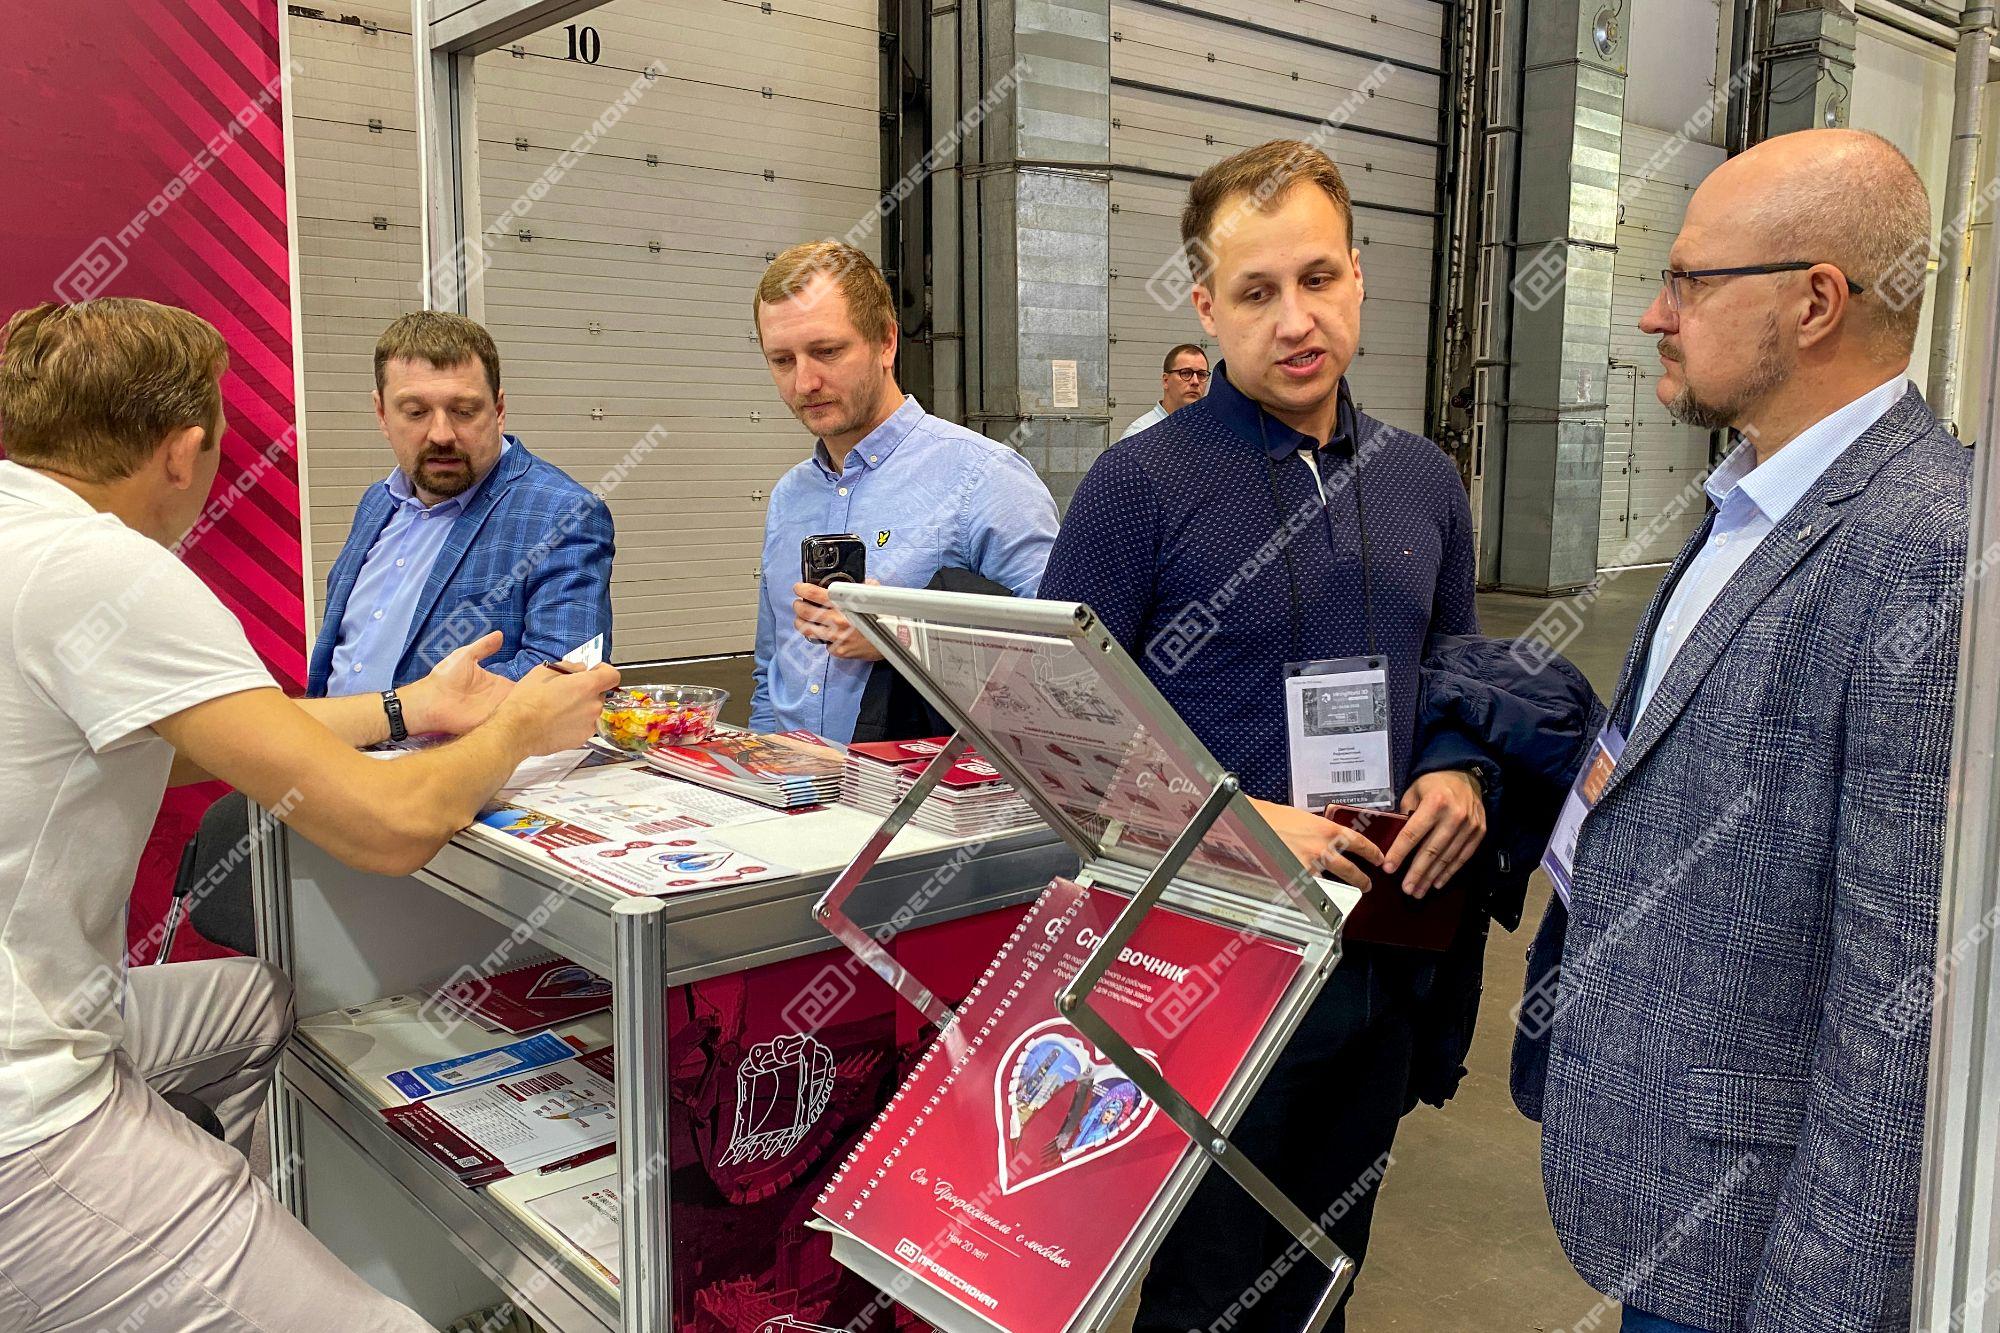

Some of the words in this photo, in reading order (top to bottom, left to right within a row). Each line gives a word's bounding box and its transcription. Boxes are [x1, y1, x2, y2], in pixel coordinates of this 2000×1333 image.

[563, 24, 601, 64] 10
[1075, 927, 1191, 985] Спвочник
[946, 1231, 963, 1247] Нам
[960, 1238, 974, 1253] 20
[971, 1244, 990, 1262] лет!
[1023, 1241, 1072, 1269] любовью
[917, 1253, 1000, 1311] ПРОФЕССИОНАЛ
